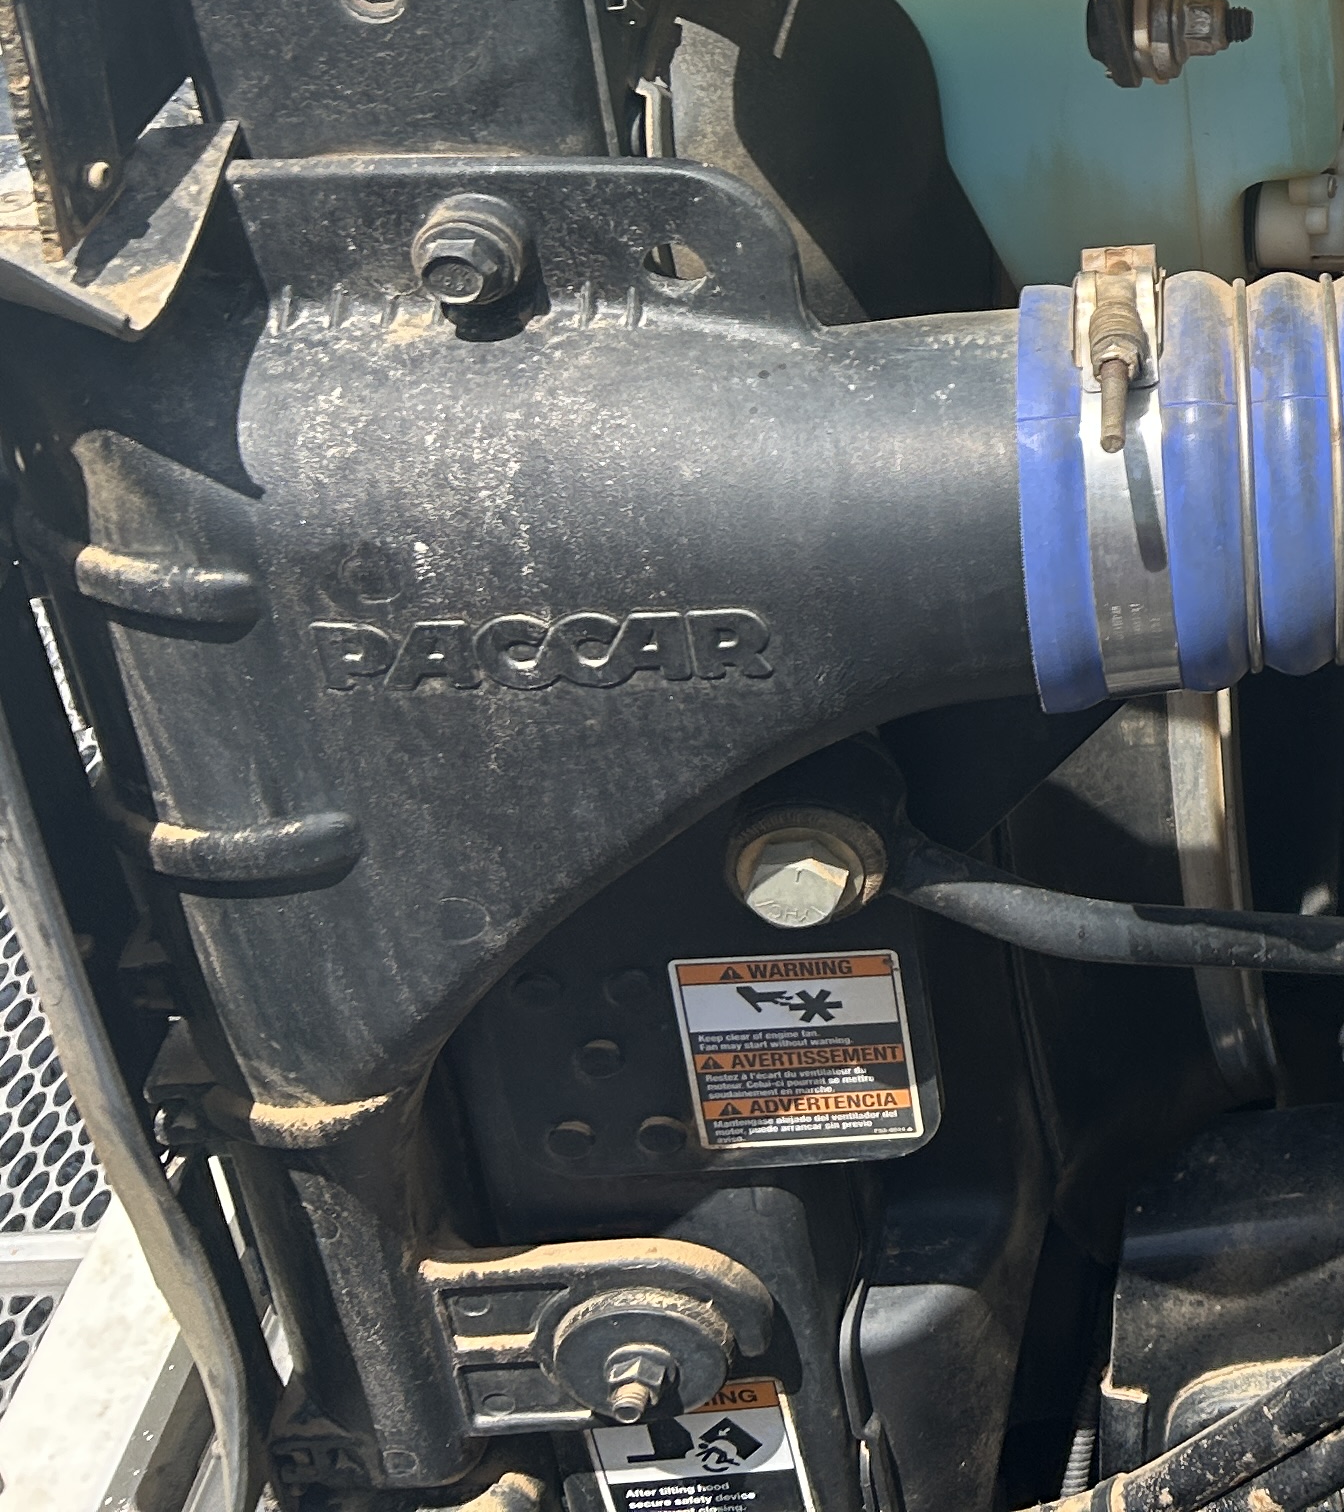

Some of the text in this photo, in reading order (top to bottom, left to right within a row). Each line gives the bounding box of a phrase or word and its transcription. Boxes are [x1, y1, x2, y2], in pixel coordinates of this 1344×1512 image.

[308, 607, 776, 693] PACCAR
[746, 958, 853, 981] WARNING
[698, 1033, 724, 1044] Keep
[725, 1032, 751, 1042] clear
[765, 1030, 799, 1041] engine
[801, 1029, 821, 1039] fan.
[699, 1036, 854, 1052] Fan may start without warning.
[730, 1045, 900, 1070] AVERTISSEMENT
[749, 1091, 899, 1115] ADVERTENCIA
[625, 1481, 730, 1500] After tilting hood
[628, 1490, 757, 1510] secure safety device
